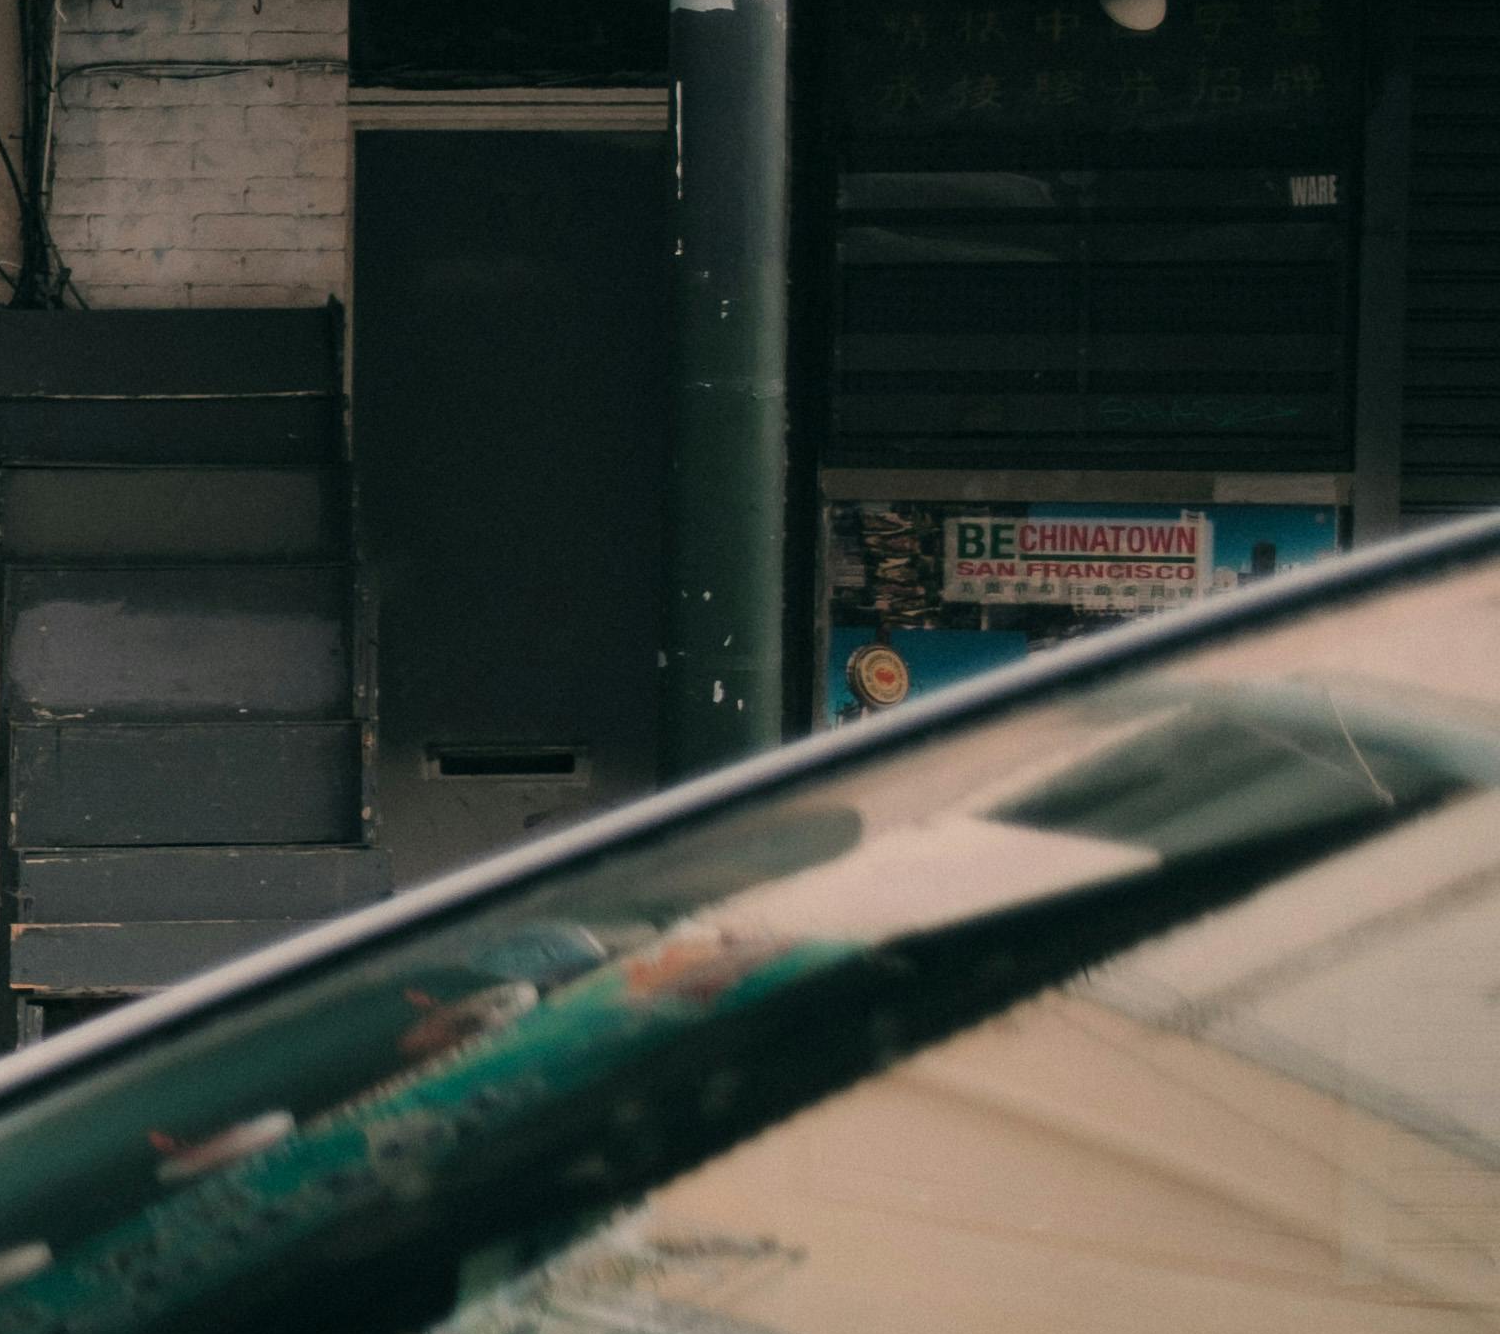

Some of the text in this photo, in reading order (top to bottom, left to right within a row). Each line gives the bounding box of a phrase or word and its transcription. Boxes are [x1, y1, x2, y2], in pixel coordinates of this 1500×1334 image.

[956, 523, 1197, 560] BE CHINATOWN
[955, 561, 1196, 581] SAN FRANCISCO
